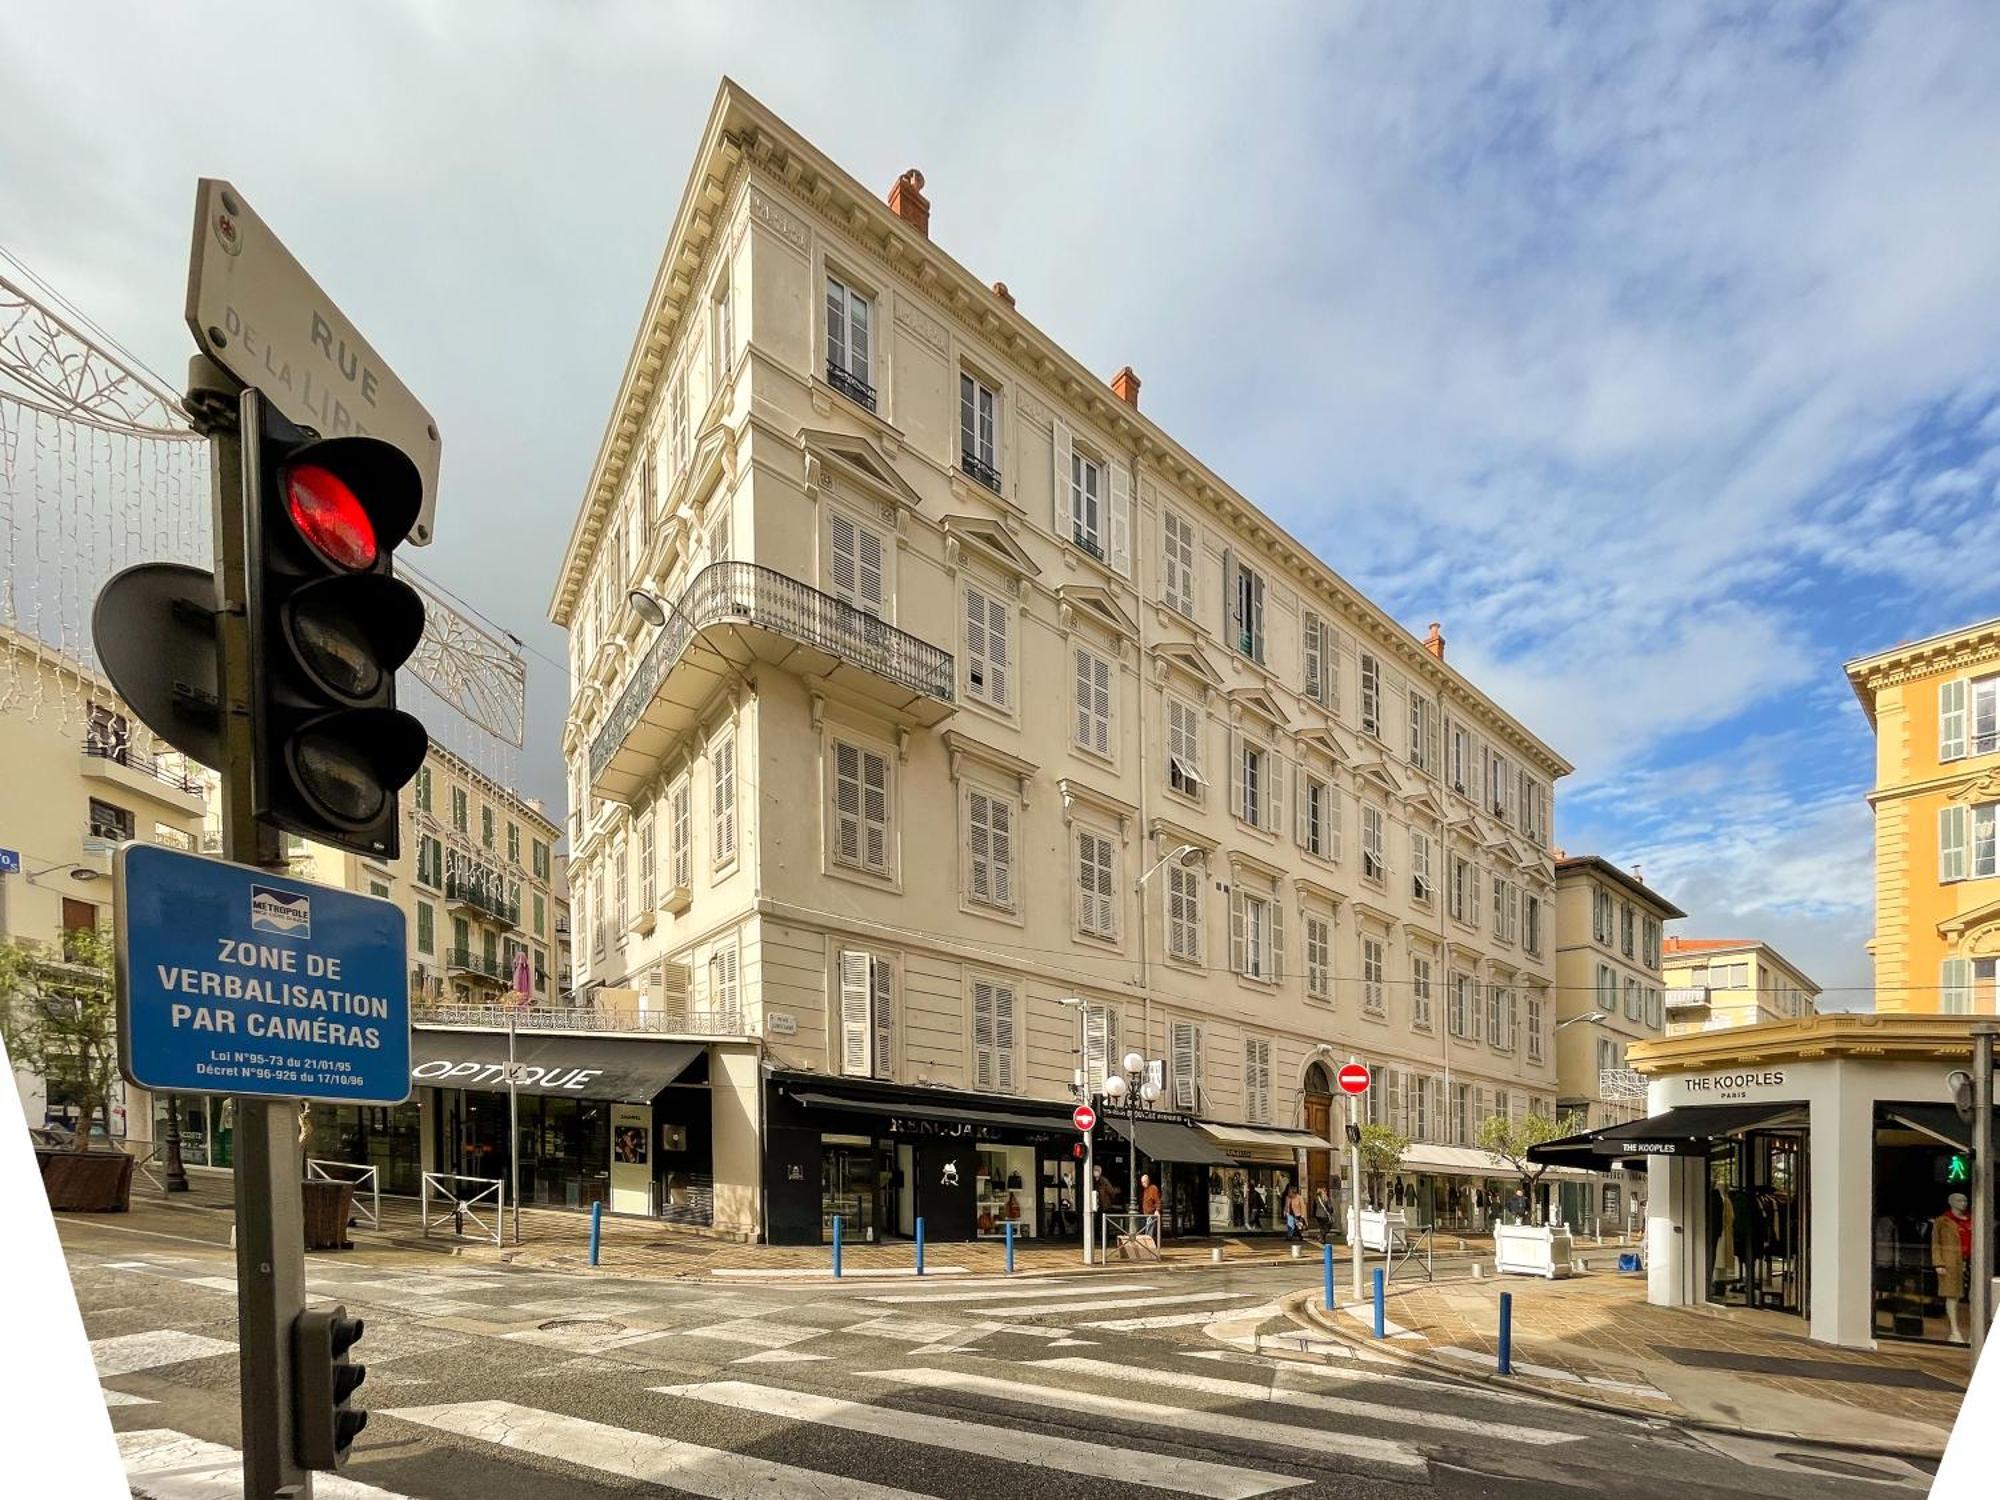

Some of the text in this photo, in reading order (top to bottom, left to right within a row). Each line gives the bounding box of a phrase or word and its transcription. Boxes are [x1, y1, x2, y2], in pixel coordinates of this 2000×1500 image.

[225, 306, 257, 357] DE
[266, 345, 293, 392] LA
[311, 310, 378, 408] RUE
[217, 938, 342, 981] ZONE DE
[157, 965, 388, 1019] VERBALISATION
[171, 1003, 380, 1050] PAR CAMÉRAS
[196, 1063, 364, 1087] Décret N°96-926 du 17/10/96
[210, 1050, 352, 1072] Loi N°95-73 du 21/01/95
[1685, 1071, 1784, 1091] THE KOOPLES
[1720, 1091, 1747, 1099] PARIS
[1622, 1143, 1676, 1153] THE KOOPLES
